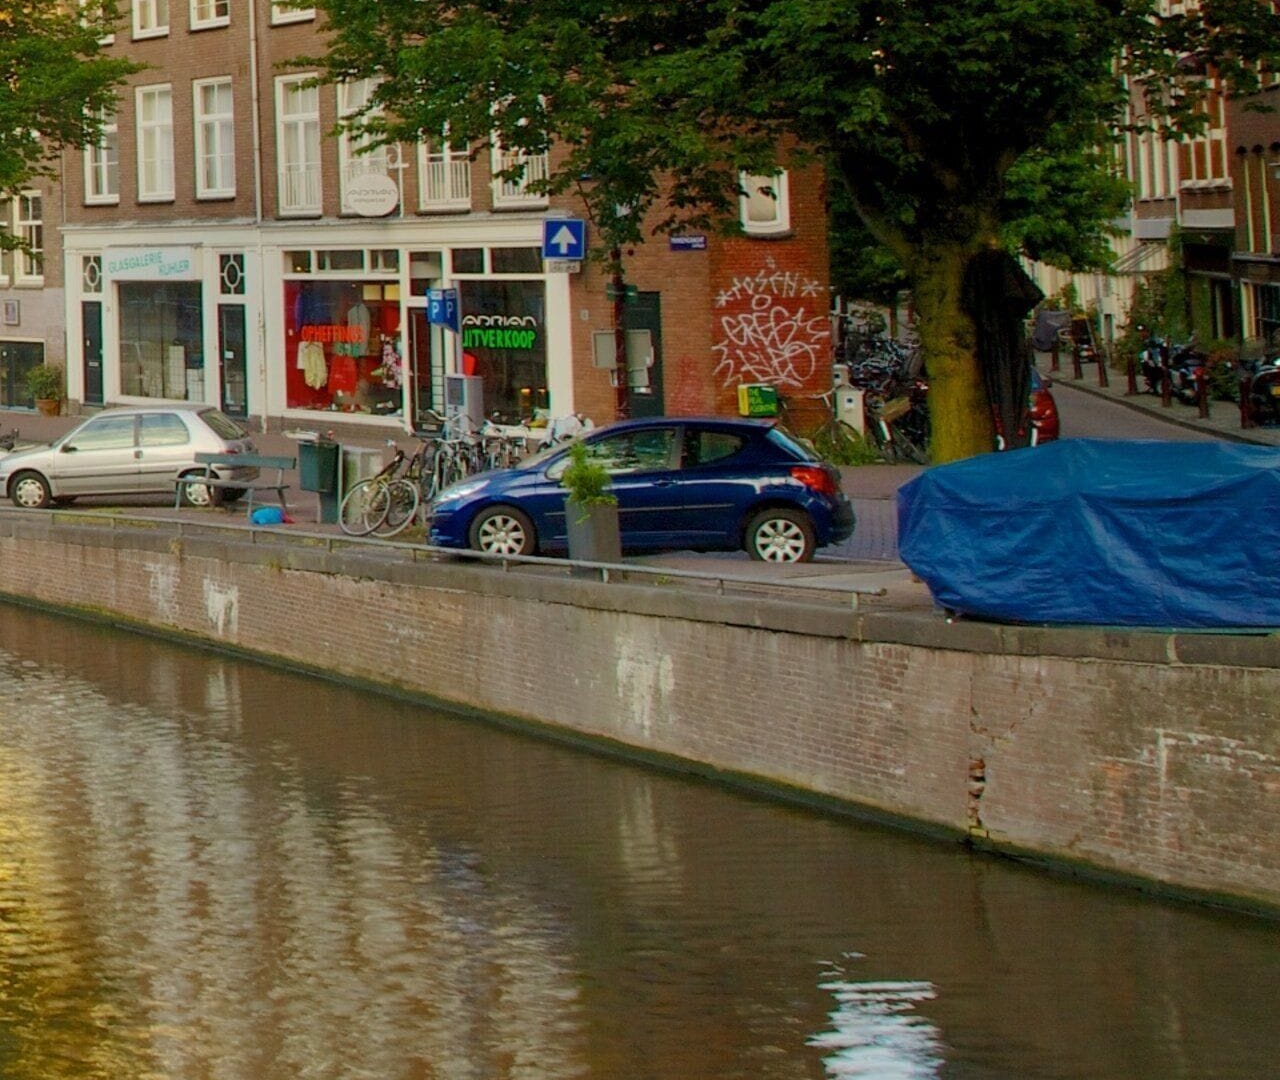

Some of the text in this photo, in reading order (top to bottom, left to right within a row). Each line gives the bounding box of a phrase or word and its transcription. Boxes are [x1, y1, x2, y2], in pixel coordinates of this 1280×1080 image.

[108, 251, 162, 274] GLASGALERIE
[431, 301, 440, 319] P
[462, 315, 537, 327] ADRIAN
